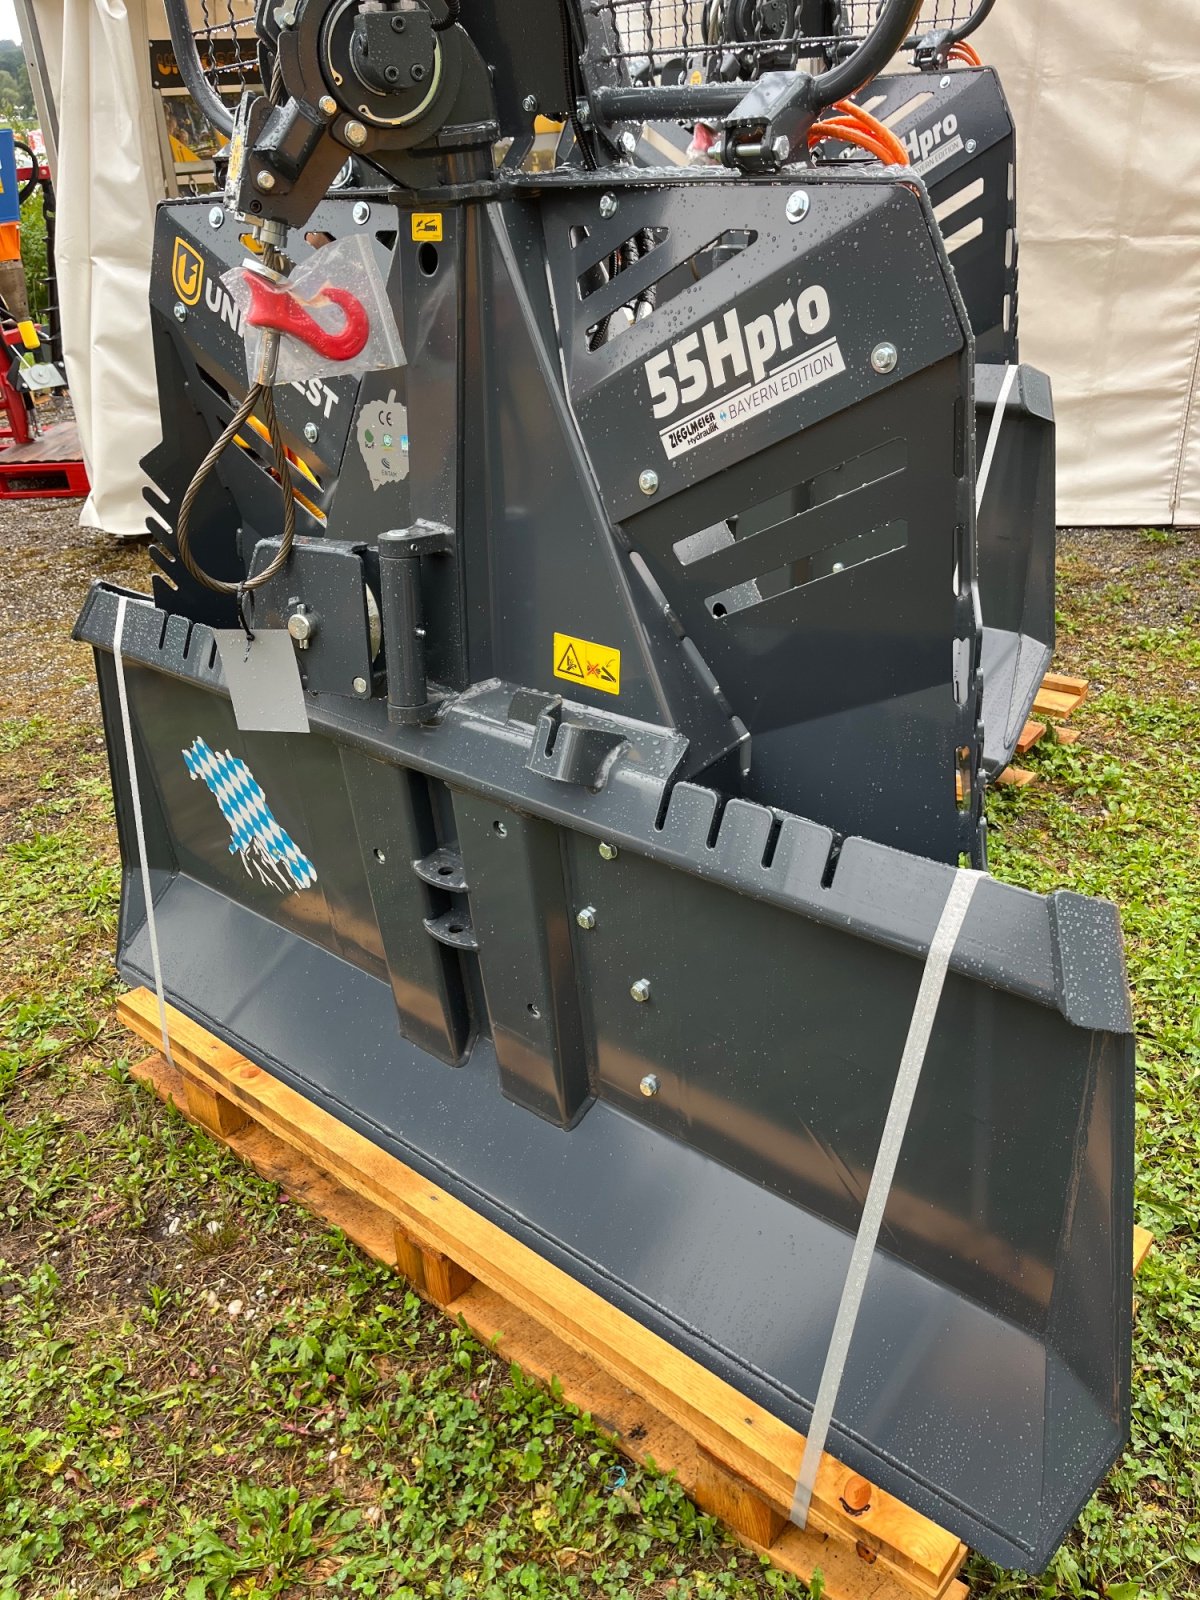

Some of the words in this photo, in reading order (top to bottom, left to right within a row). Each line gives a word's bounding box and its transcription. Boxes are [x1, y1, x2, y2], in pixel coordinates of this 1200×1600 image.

[934, 141, 960, 162] EDITION
[644, 284, 831, 420] 55Hpro
[728, 382, 779, 420] BAYERN
[780, 352, 834, 392] EDITION
[378, 410, 393, 427] CE
[668, 411, 716, 449] ZIEGLMEIER
[686, 421, 720, 446] Hydraulik
